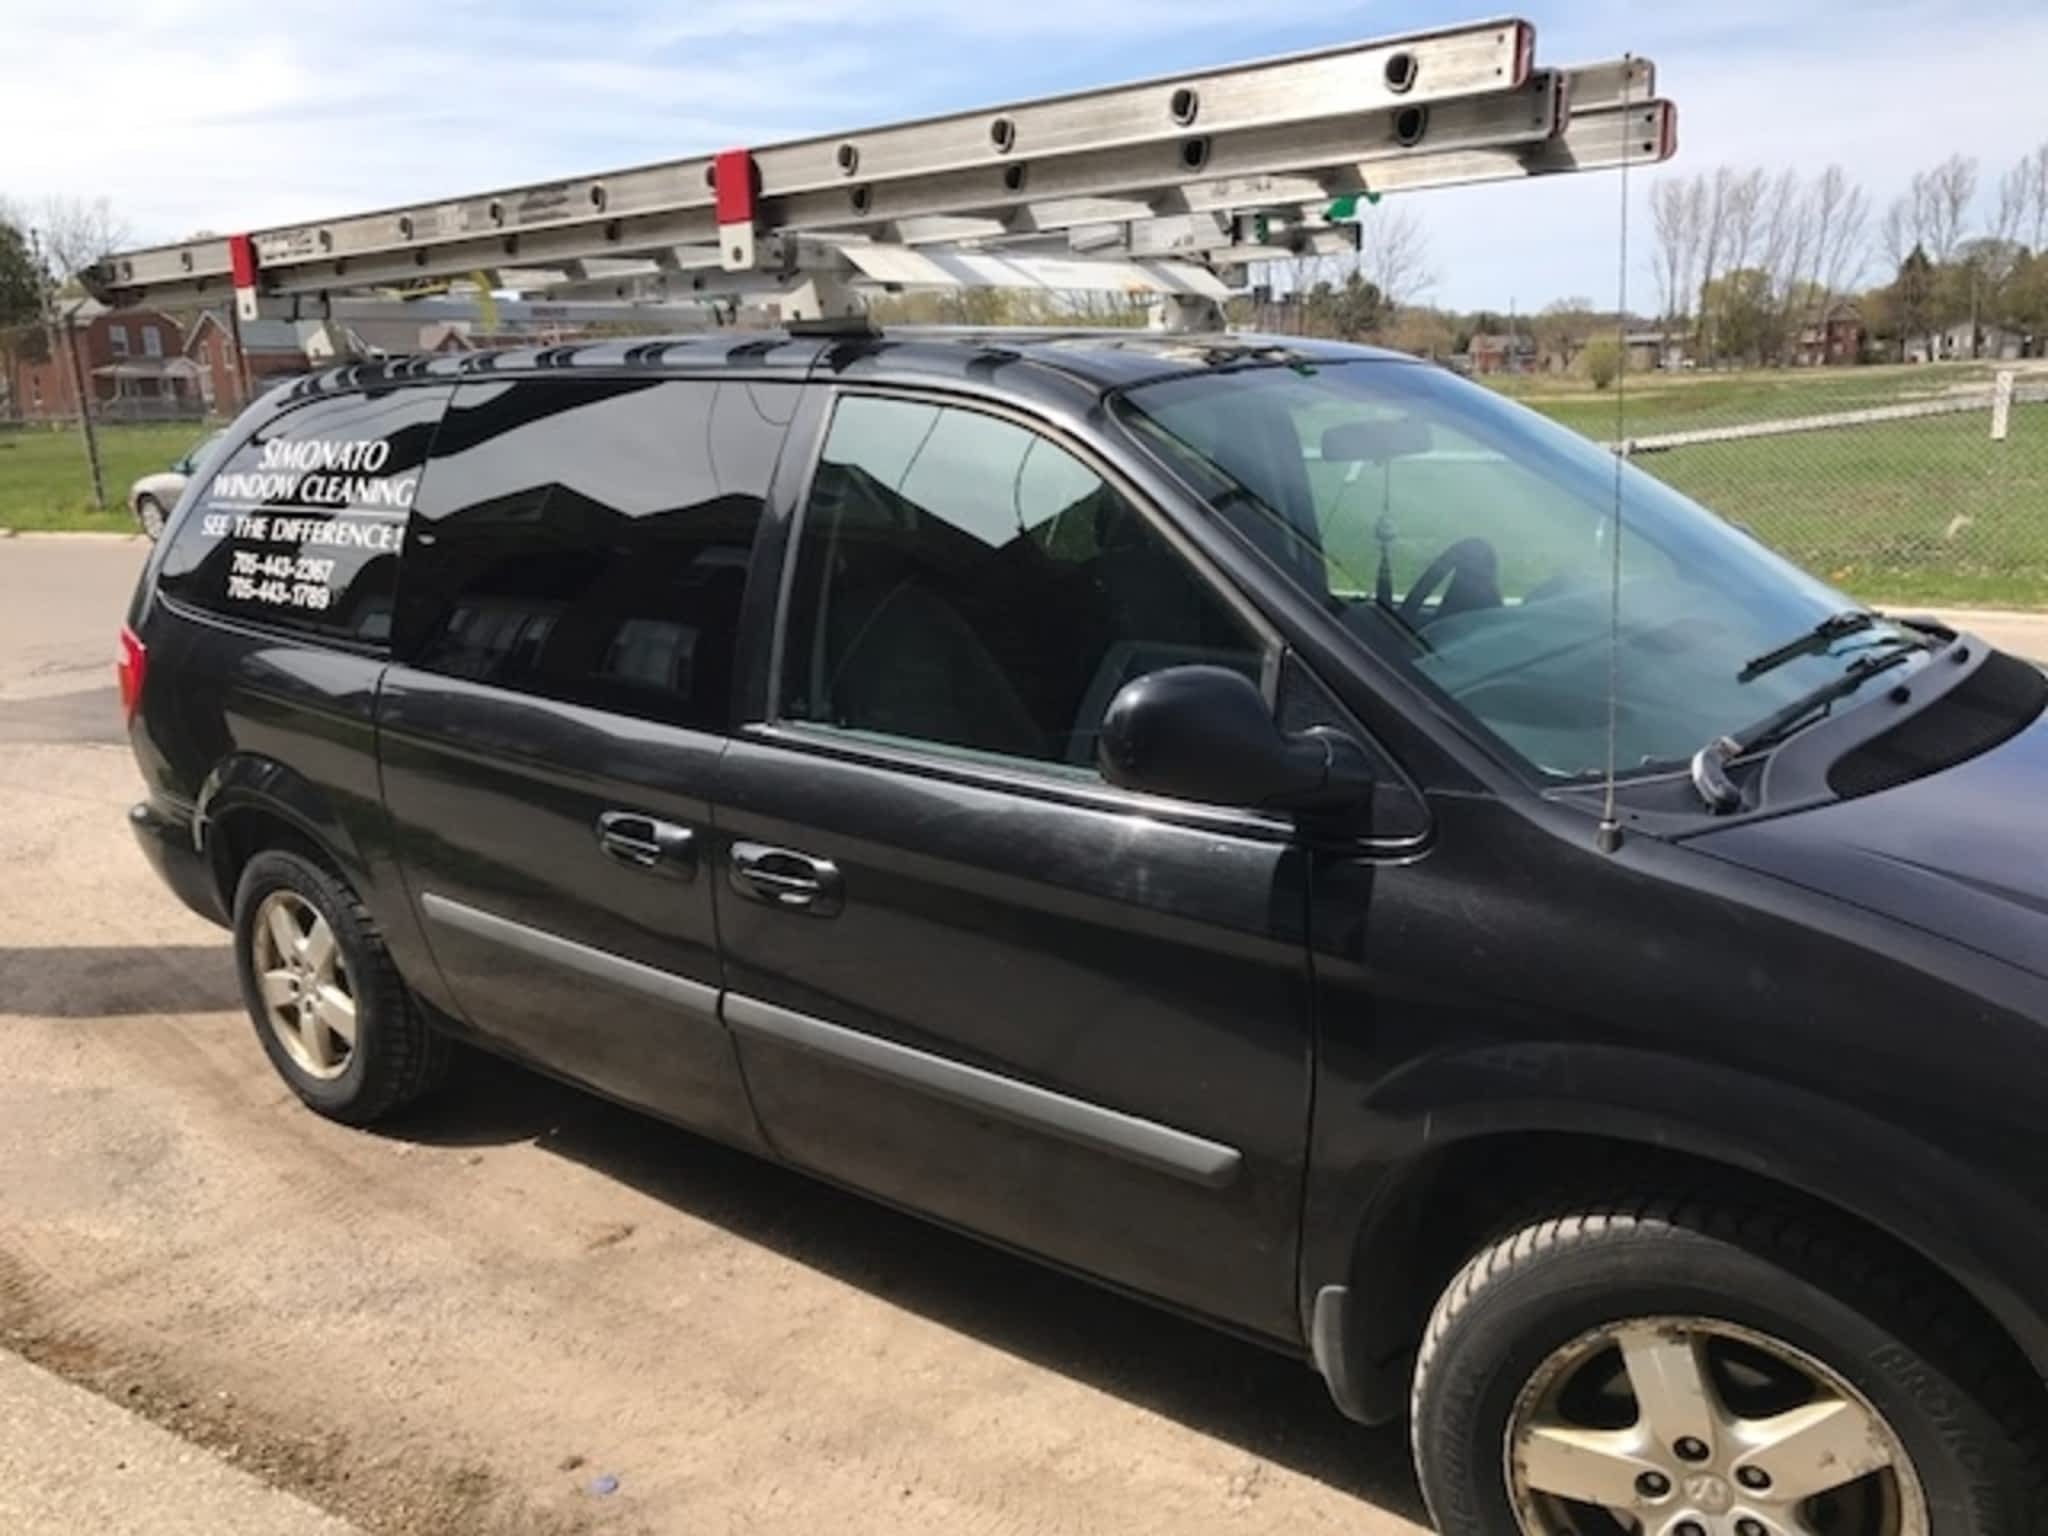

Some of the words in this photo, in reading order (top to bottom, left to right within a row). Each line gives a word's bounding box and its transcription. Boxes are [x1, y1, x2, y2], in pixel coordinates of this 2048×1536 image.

[258, 438, 390, 471] SIMONATO
[213, 474, 295, 500] WINDOW
[301, 476, 416, 507] CLEANING
[201, 514, 230, 535] SEE
[234, 515, 268, 540] THE
[271, 519, 405, 551] DIFFERENCE!
